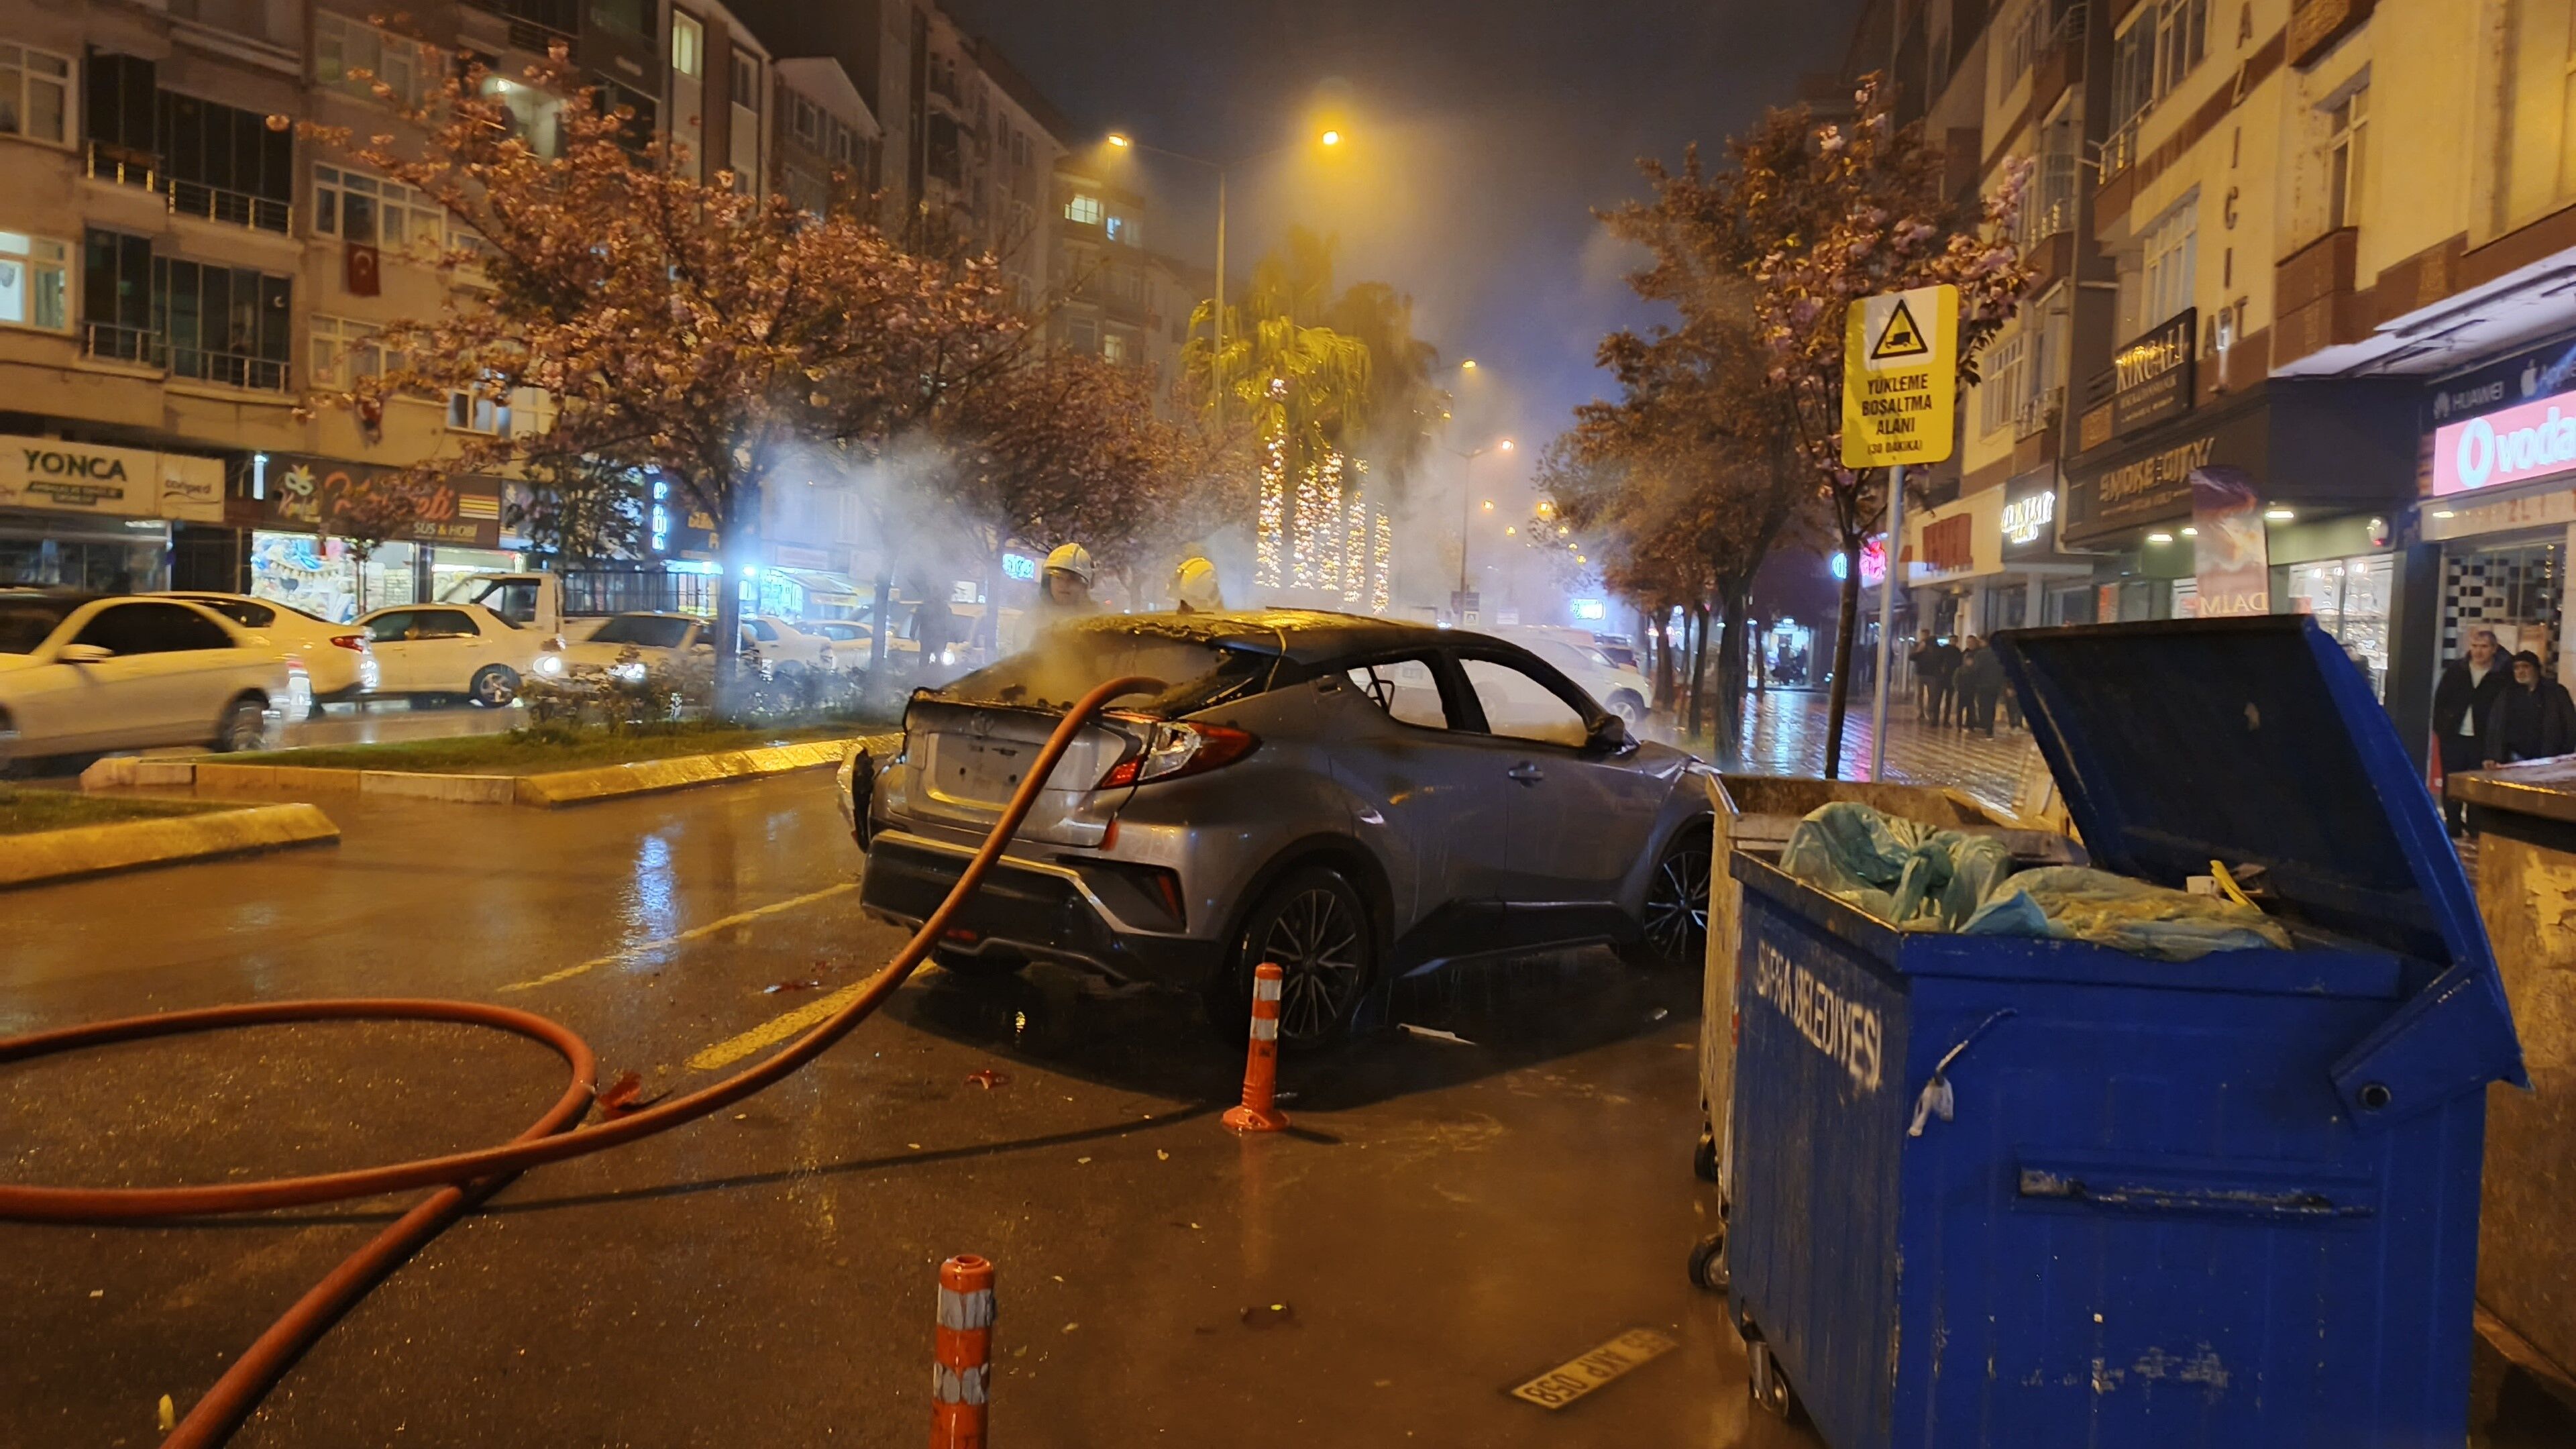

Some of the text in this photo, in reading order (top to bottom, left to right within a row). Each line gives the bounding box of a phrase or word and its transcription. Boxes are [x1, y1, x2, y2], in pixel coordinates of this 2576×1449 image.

[1868, 373, 1929, 394] YÜKLEME
[2452, 380, 2504, 411] HUAWEI
[1862, 394, 1933, 416] BOŞALTMA
[1876, 417, 1916, 435] ALANI
[23, 449, 127, 482] YONCA
[1523, 1373, 1589, 1404] 058
